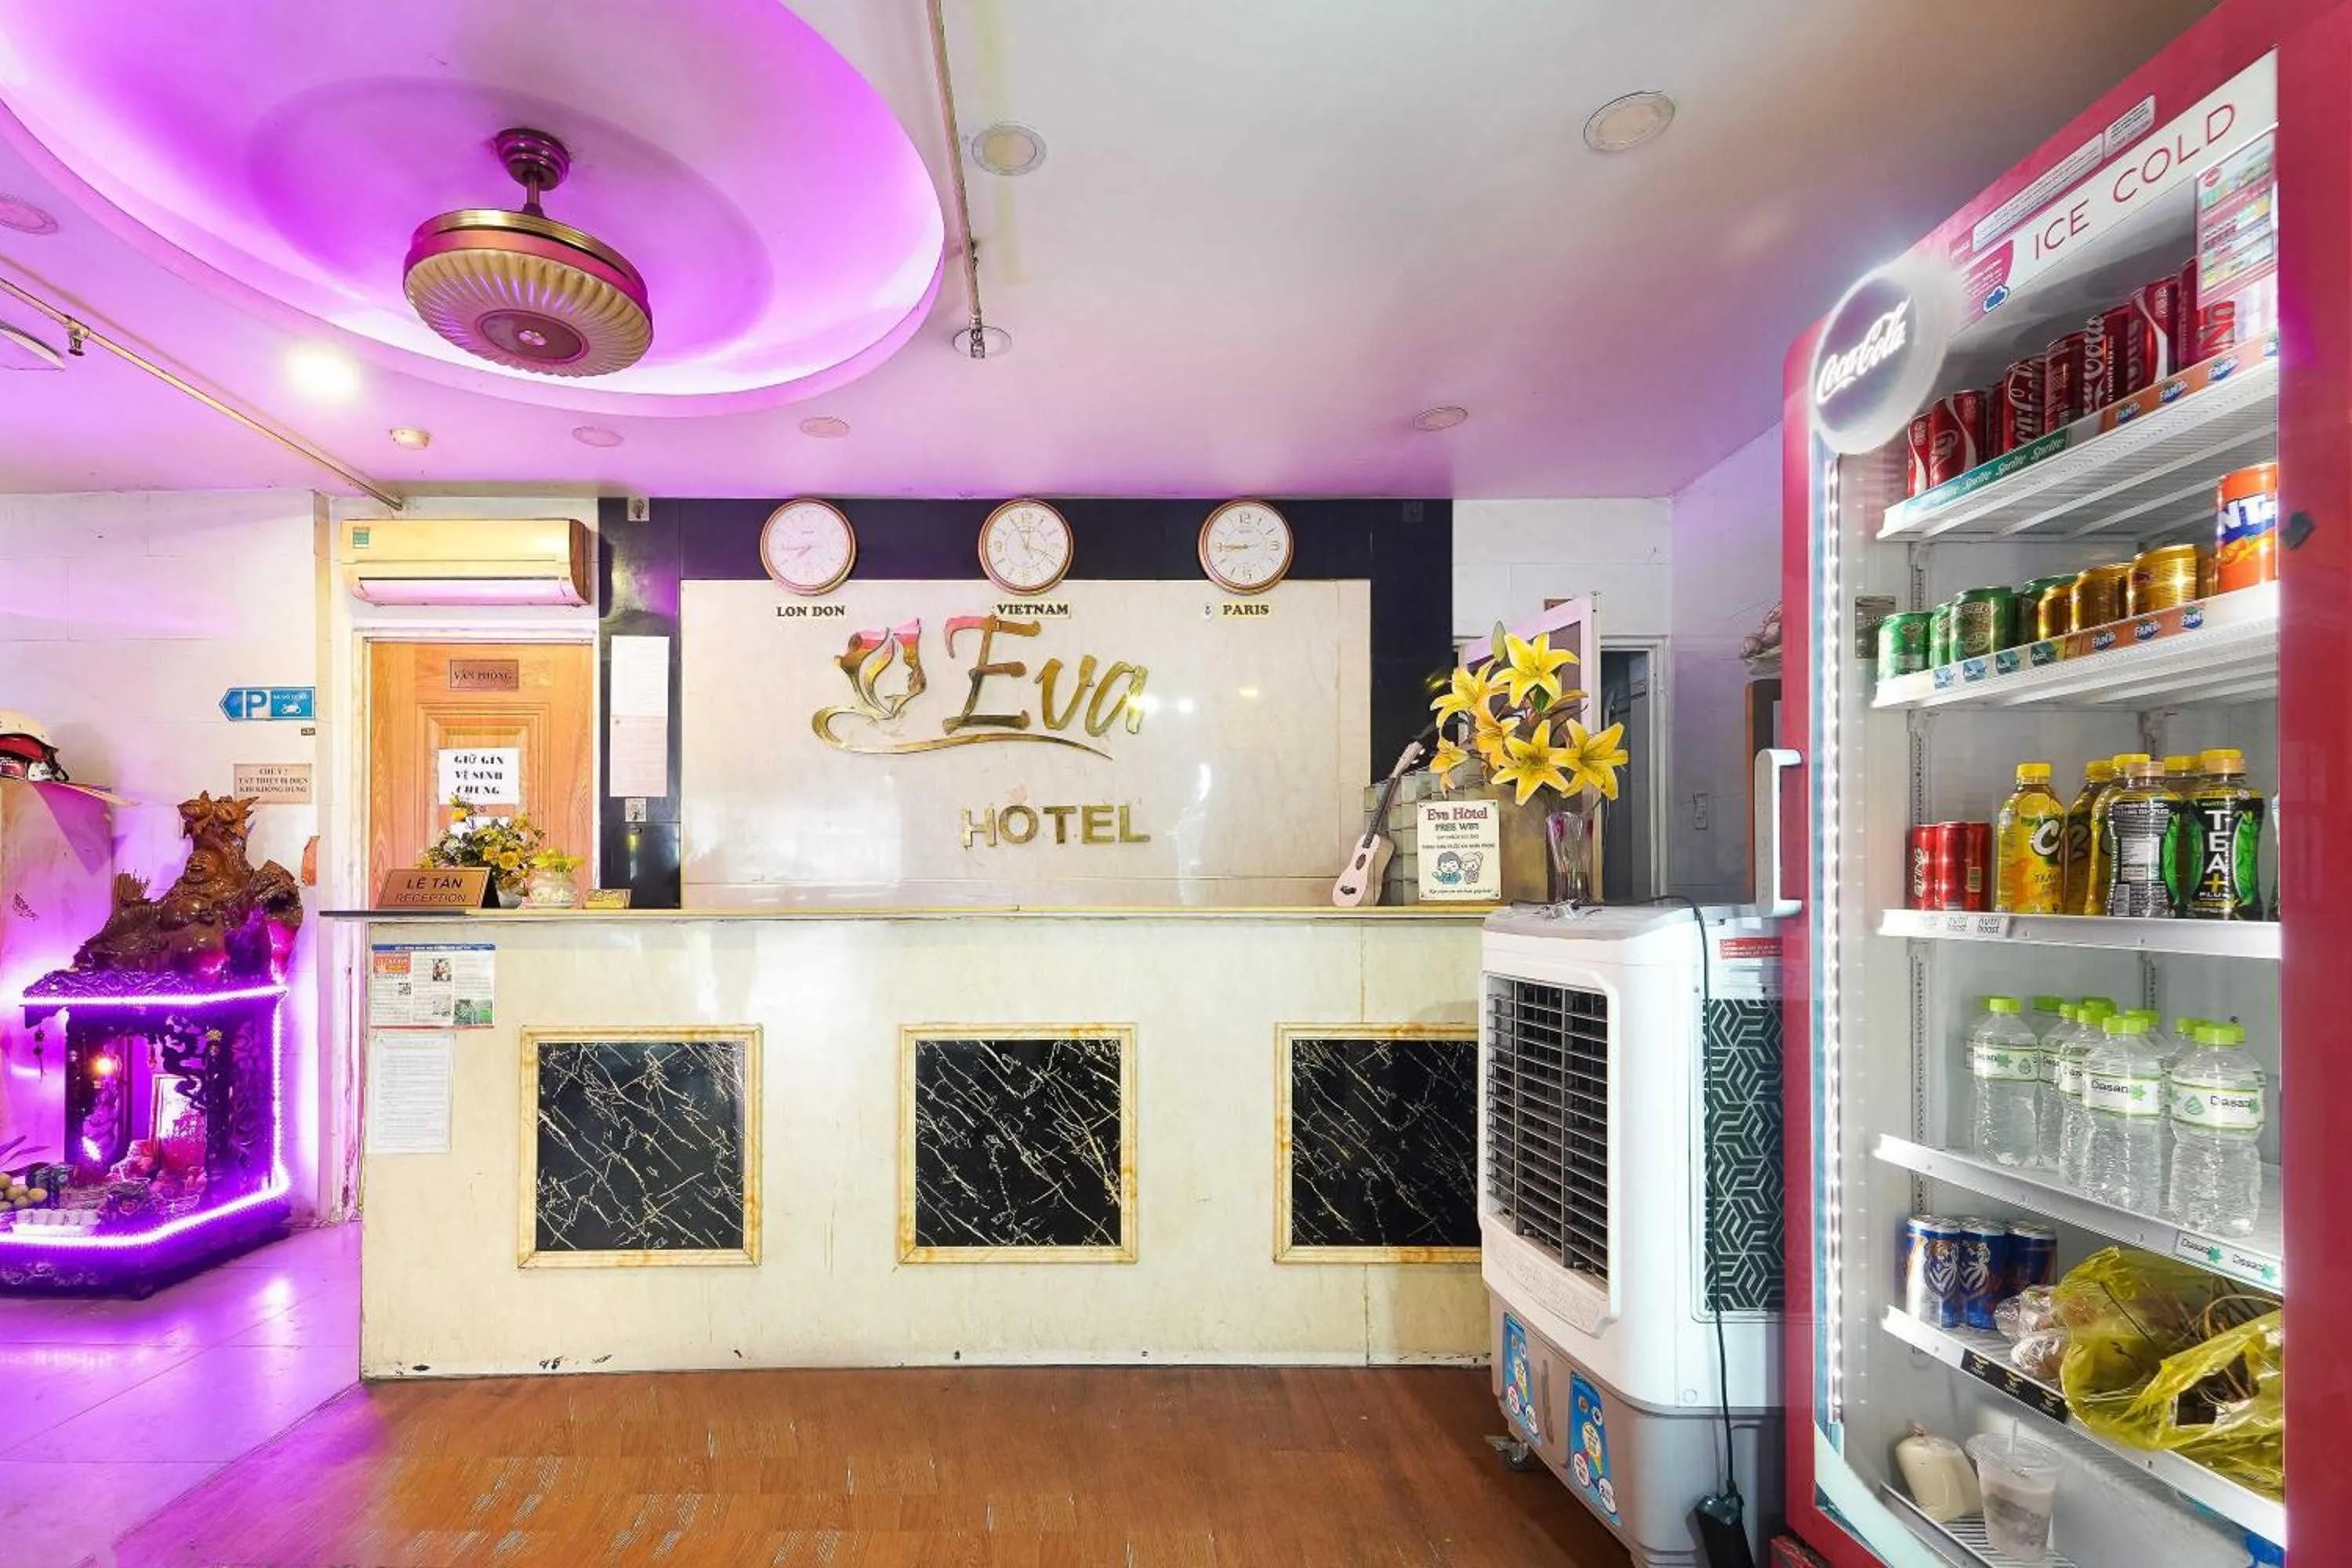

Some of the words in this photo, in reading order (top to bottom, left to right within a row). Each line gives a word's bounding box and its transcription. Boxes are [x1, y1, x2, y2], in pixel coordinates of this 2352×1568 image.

[2034, 198, 2089, 260] ICE
[2113, 103, 2235, 202] COLD
[776, 606, 808, 617] LON
[812, 605, 845, 616] DON
[997, 604, 1069, 615] VIETNAM
[1223, 604, 1269, 615] PARIS
[945, 615, 1149, 736] Eva
[246, 691, 267, 718] P
[472, 770, 503, 780] SINH
[456, 785, 499, 794] CHUNG
[1427, 808, 1449, 821] Eva
[960, 802, 1150, 850] HOTEL
[1913, 847, 1929, 898] STING
[394, 892, 466, 902] RECEPTION
